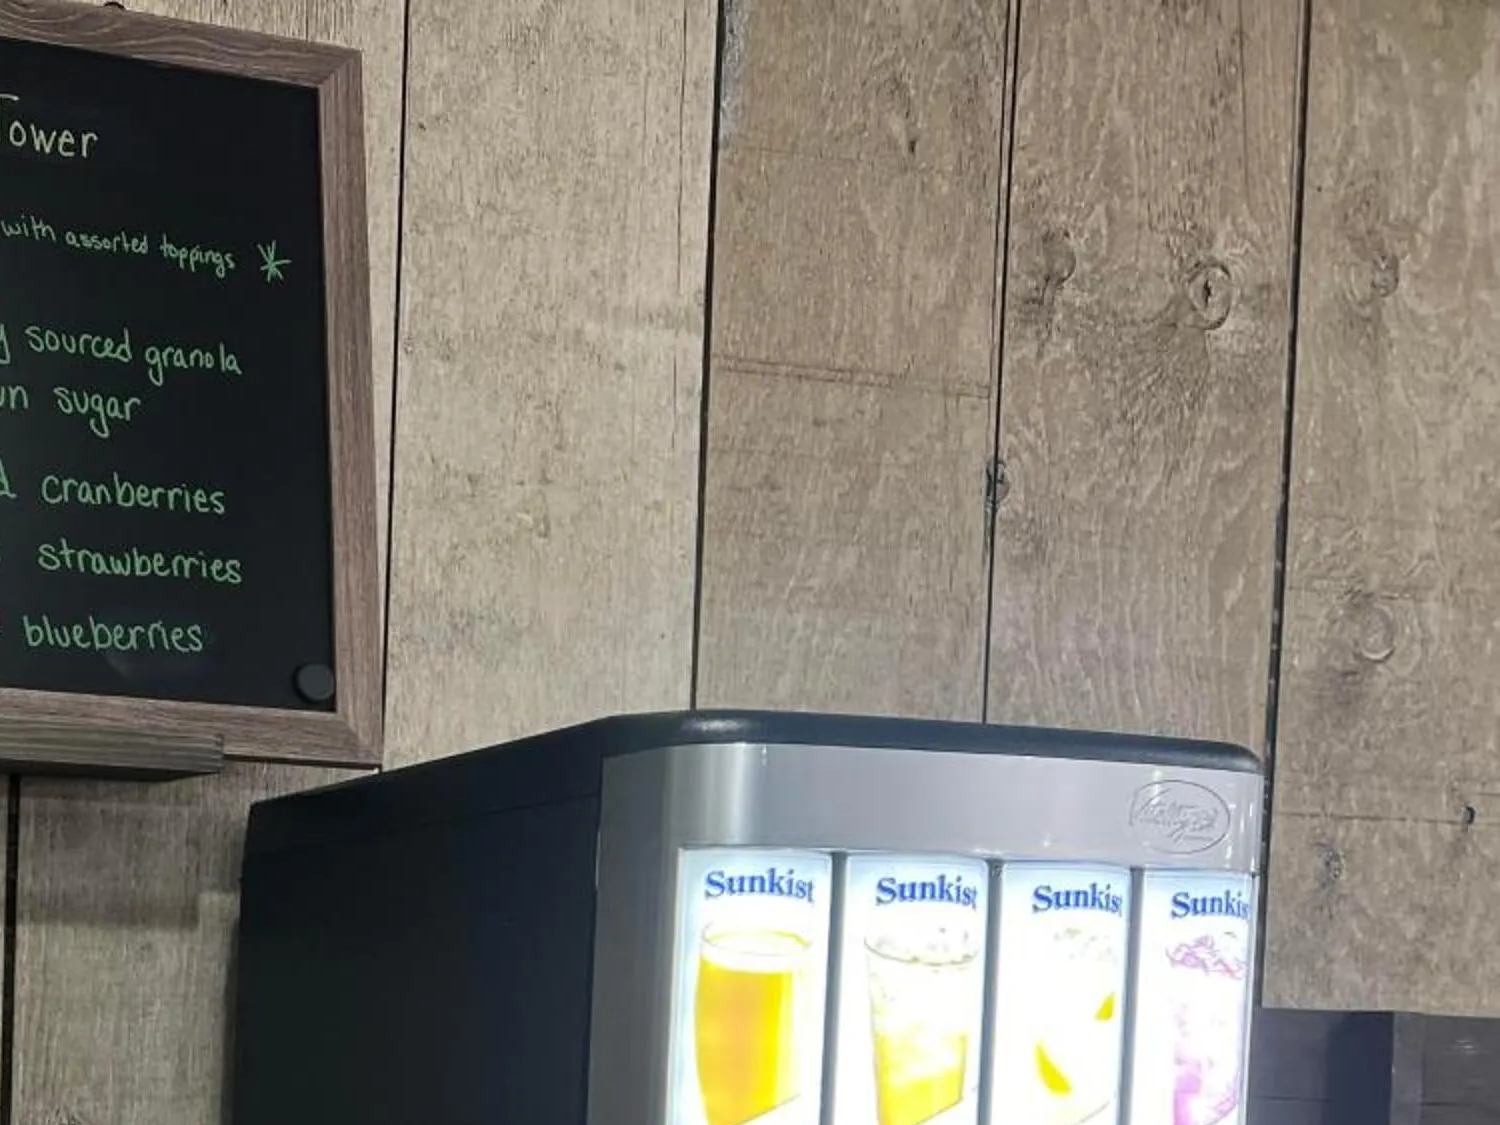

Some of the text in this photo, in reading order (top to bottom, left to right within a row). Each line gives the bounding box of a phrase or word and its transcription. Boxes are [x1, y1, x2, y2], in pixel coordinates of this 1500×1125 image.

[0, 214, 57, 242] with
[64, 230, 149, 256] assorted
[159, 235, 238, 279] toppings
[25, 325, 133, 364] sourced
[144, 340, 244, 386] granola
[54, 383, 142, 438] sugar
[40, 471, 227, 516] cranberries
[36, 537, 244, 586] strawberries
[22, 615, 206, 655] blueberries
[704, 867, 815, 903] Sunkist
[875, 873, 977, 912] Sunkist
[1171, 889, 1251, 921] Sunkis
